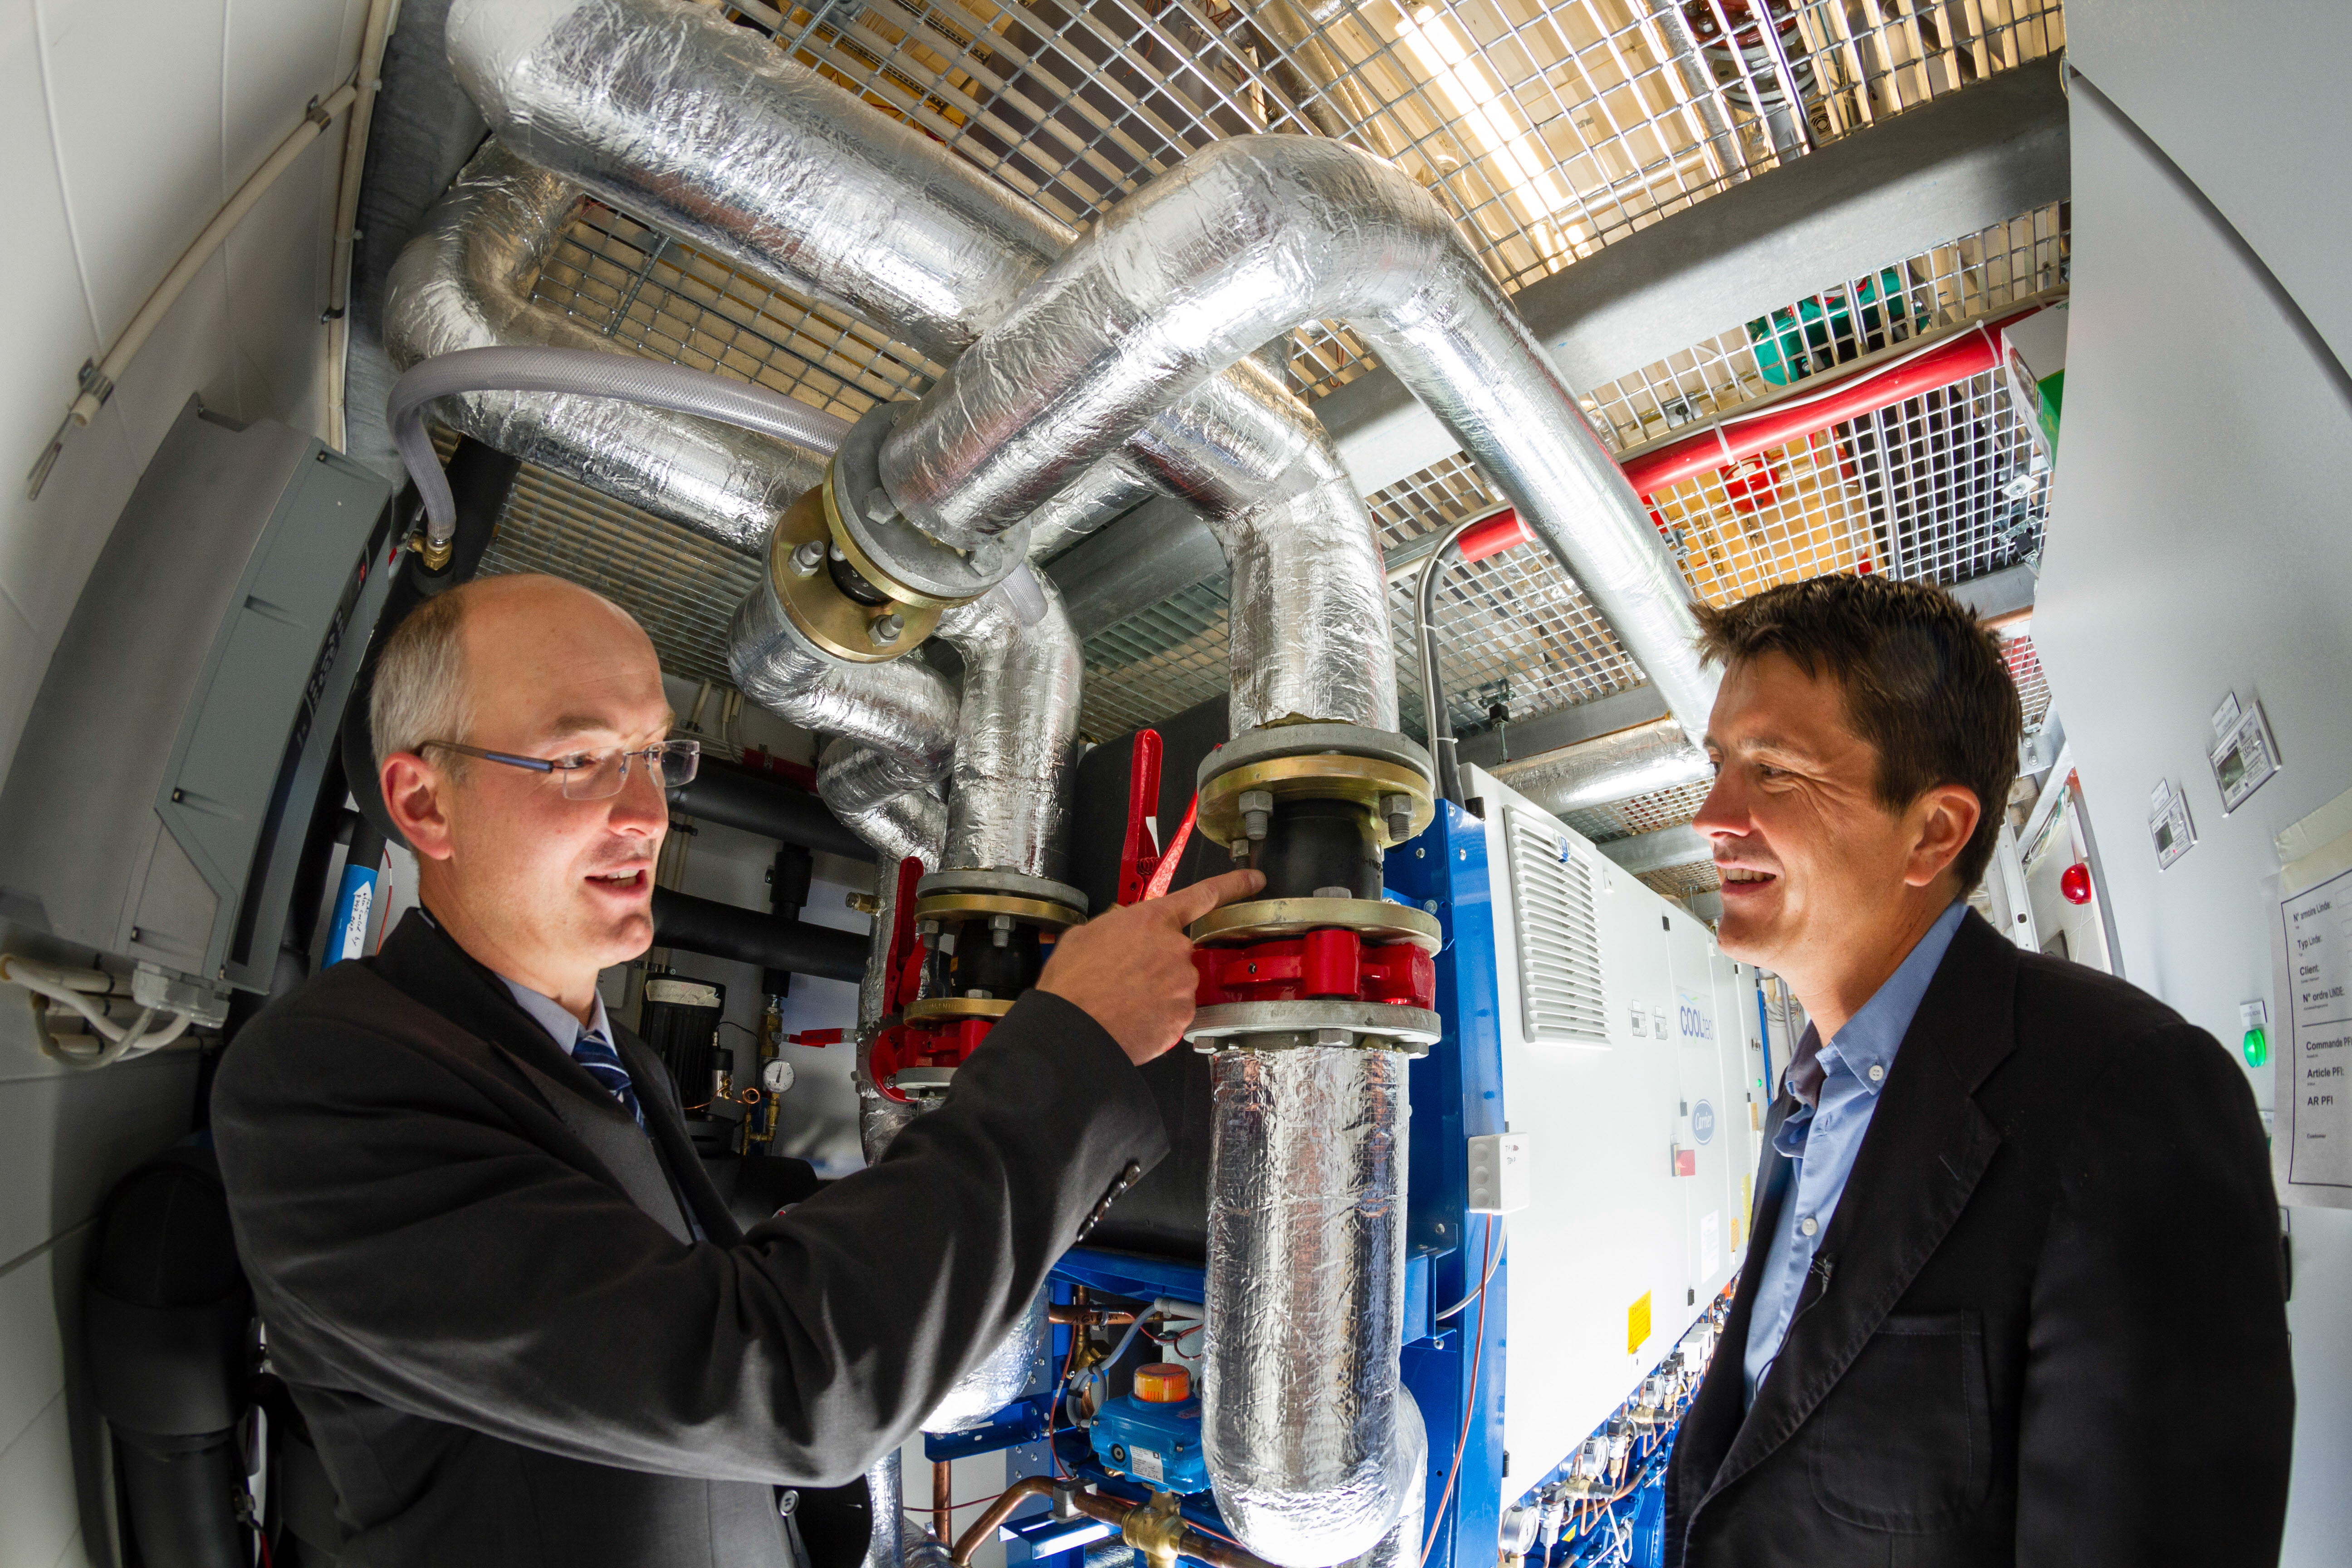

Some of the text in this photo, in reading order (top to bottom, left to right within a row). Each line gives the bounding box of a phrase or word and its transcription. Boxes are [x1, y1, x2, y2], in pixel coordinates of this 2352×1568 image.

[352, 936, 360, 946] by
[2297, 940, 2308, 951] Typ
[2303, 993, 2311, 1003] N°
[2313, 990, 2329, 1001] ordre
[1681, 1005, 1713, 1040] COOLtec
[2306, 1038, 2342, 1051] Commande
[2307, 1068, 2331, 1078] Article
[2308, 1095, 2333, 1106] AR PFI
[1695, 1111, 1712, 1131] Carrier
[1632, 1295, 1648, 1316] Caution!
